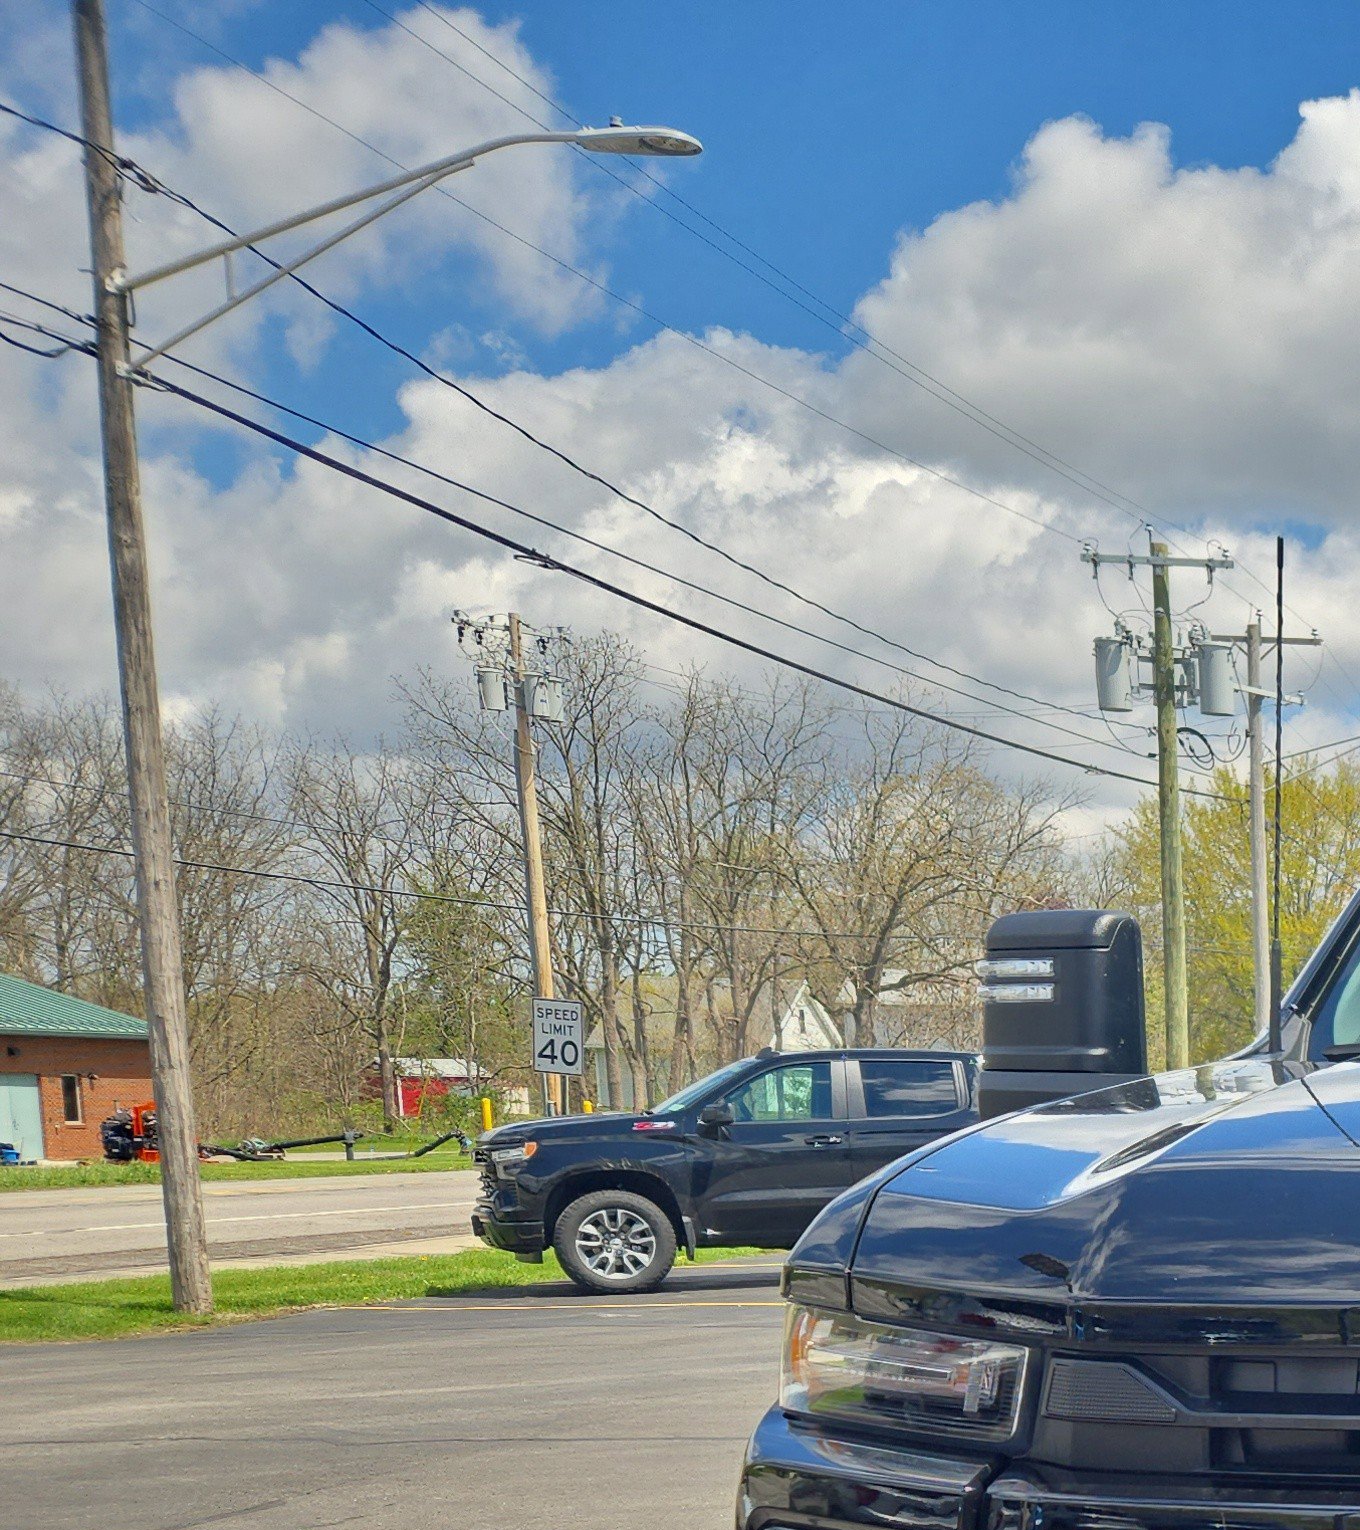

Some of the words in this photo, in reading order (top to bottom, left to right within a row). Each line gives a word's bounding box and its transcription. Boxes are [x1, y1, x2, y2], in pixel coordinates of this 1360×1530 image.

[537, 1008, 578, 1021] SPEED
[542, 1023, 574, 1036] LIMIT
[538, 1039, 578, 1066] 40
